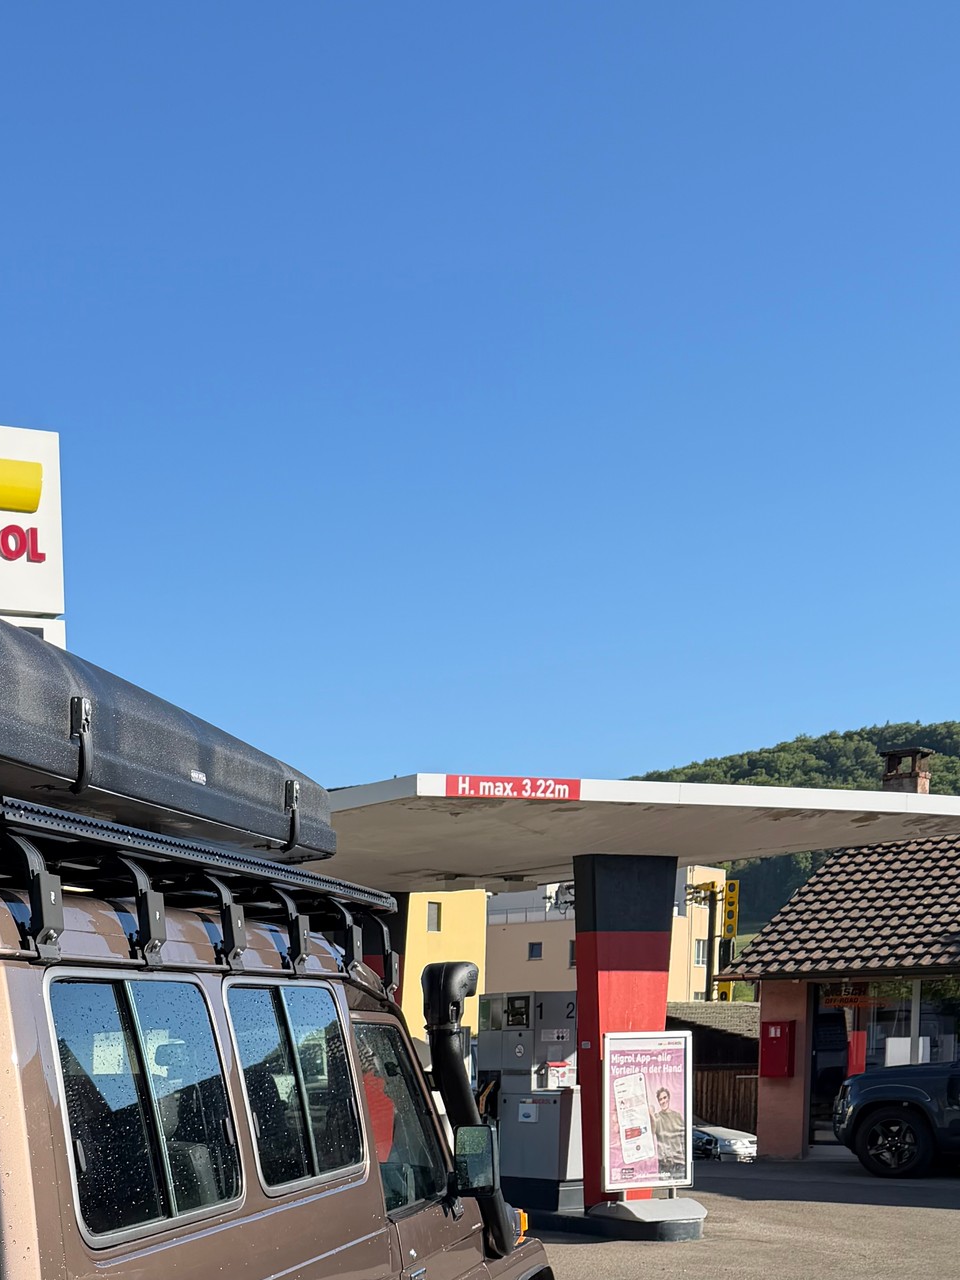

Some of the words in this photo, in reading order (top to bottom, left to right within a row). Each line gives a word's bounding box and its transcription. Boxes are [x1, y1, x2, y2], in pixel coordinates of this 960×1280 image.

[458, 776, 475, 795] H.
[479, 781, 517, 797] max.
[521, 778, 570, 798] 3.22m
[536, 1002, 543, 1020] 1
[566, 1001, 575, 1019] 2
[611, 1053, 635, 1065] Migrol
[635, 1053, 651, 1064] App
[657, 1052, 672, 1062] alle
[611, 1065, 640, 1075] Vorteile
[640, 1064, 648, 1074] in
[649, 1064, 661, 1073] der
[662, 1063, 682, 1073] Hand
